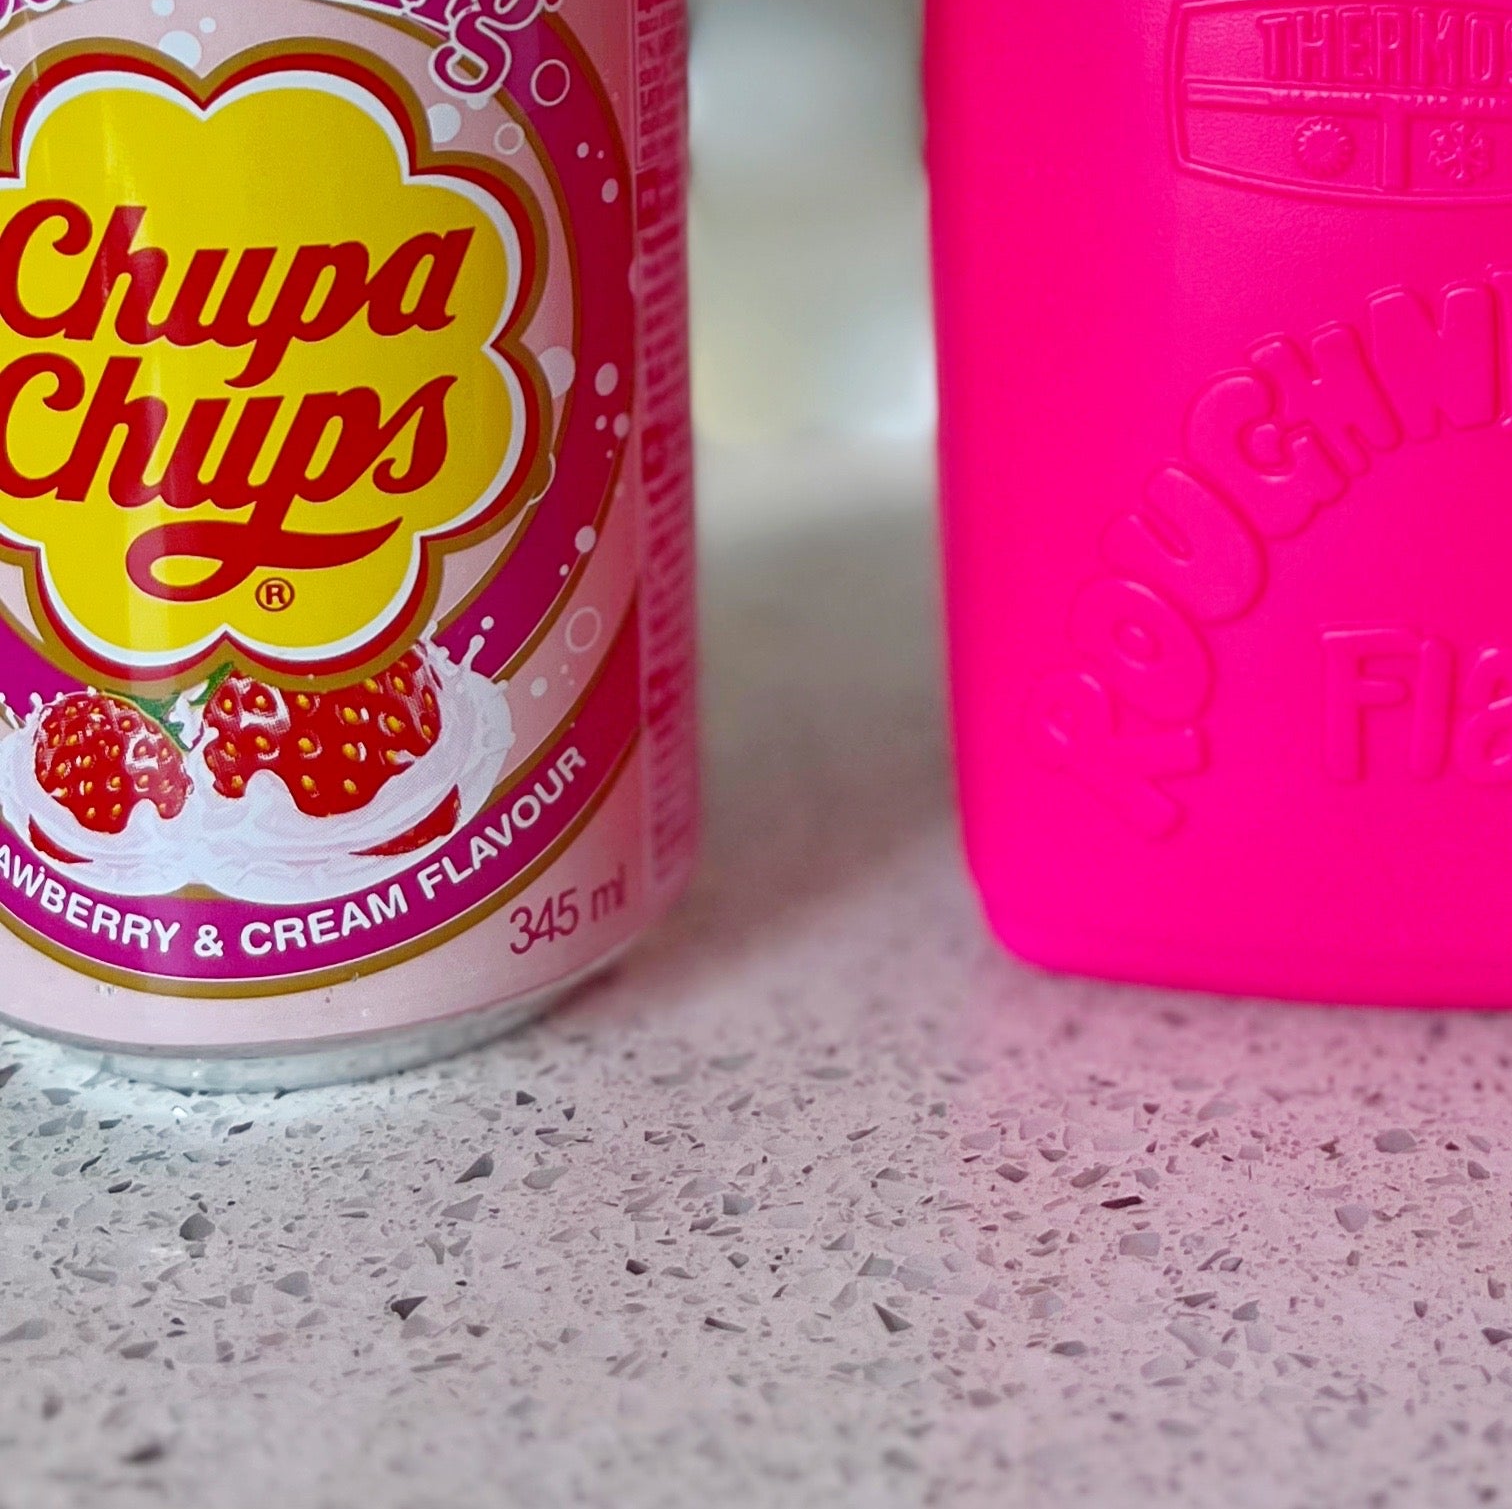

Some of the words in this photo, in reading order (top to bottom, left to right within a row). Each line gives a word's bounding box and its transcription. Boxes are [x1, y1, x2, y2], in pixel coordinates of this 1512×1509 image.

[0, 198, 475, 388] Chupa
[0, 352, 457, 601] Chups
[196, 923, 225, 958] &
[241, 884, 409, 957] CREAM
[417, 746, 588, 900] FLAVOUR
[509, 888, 580, 955] 345
